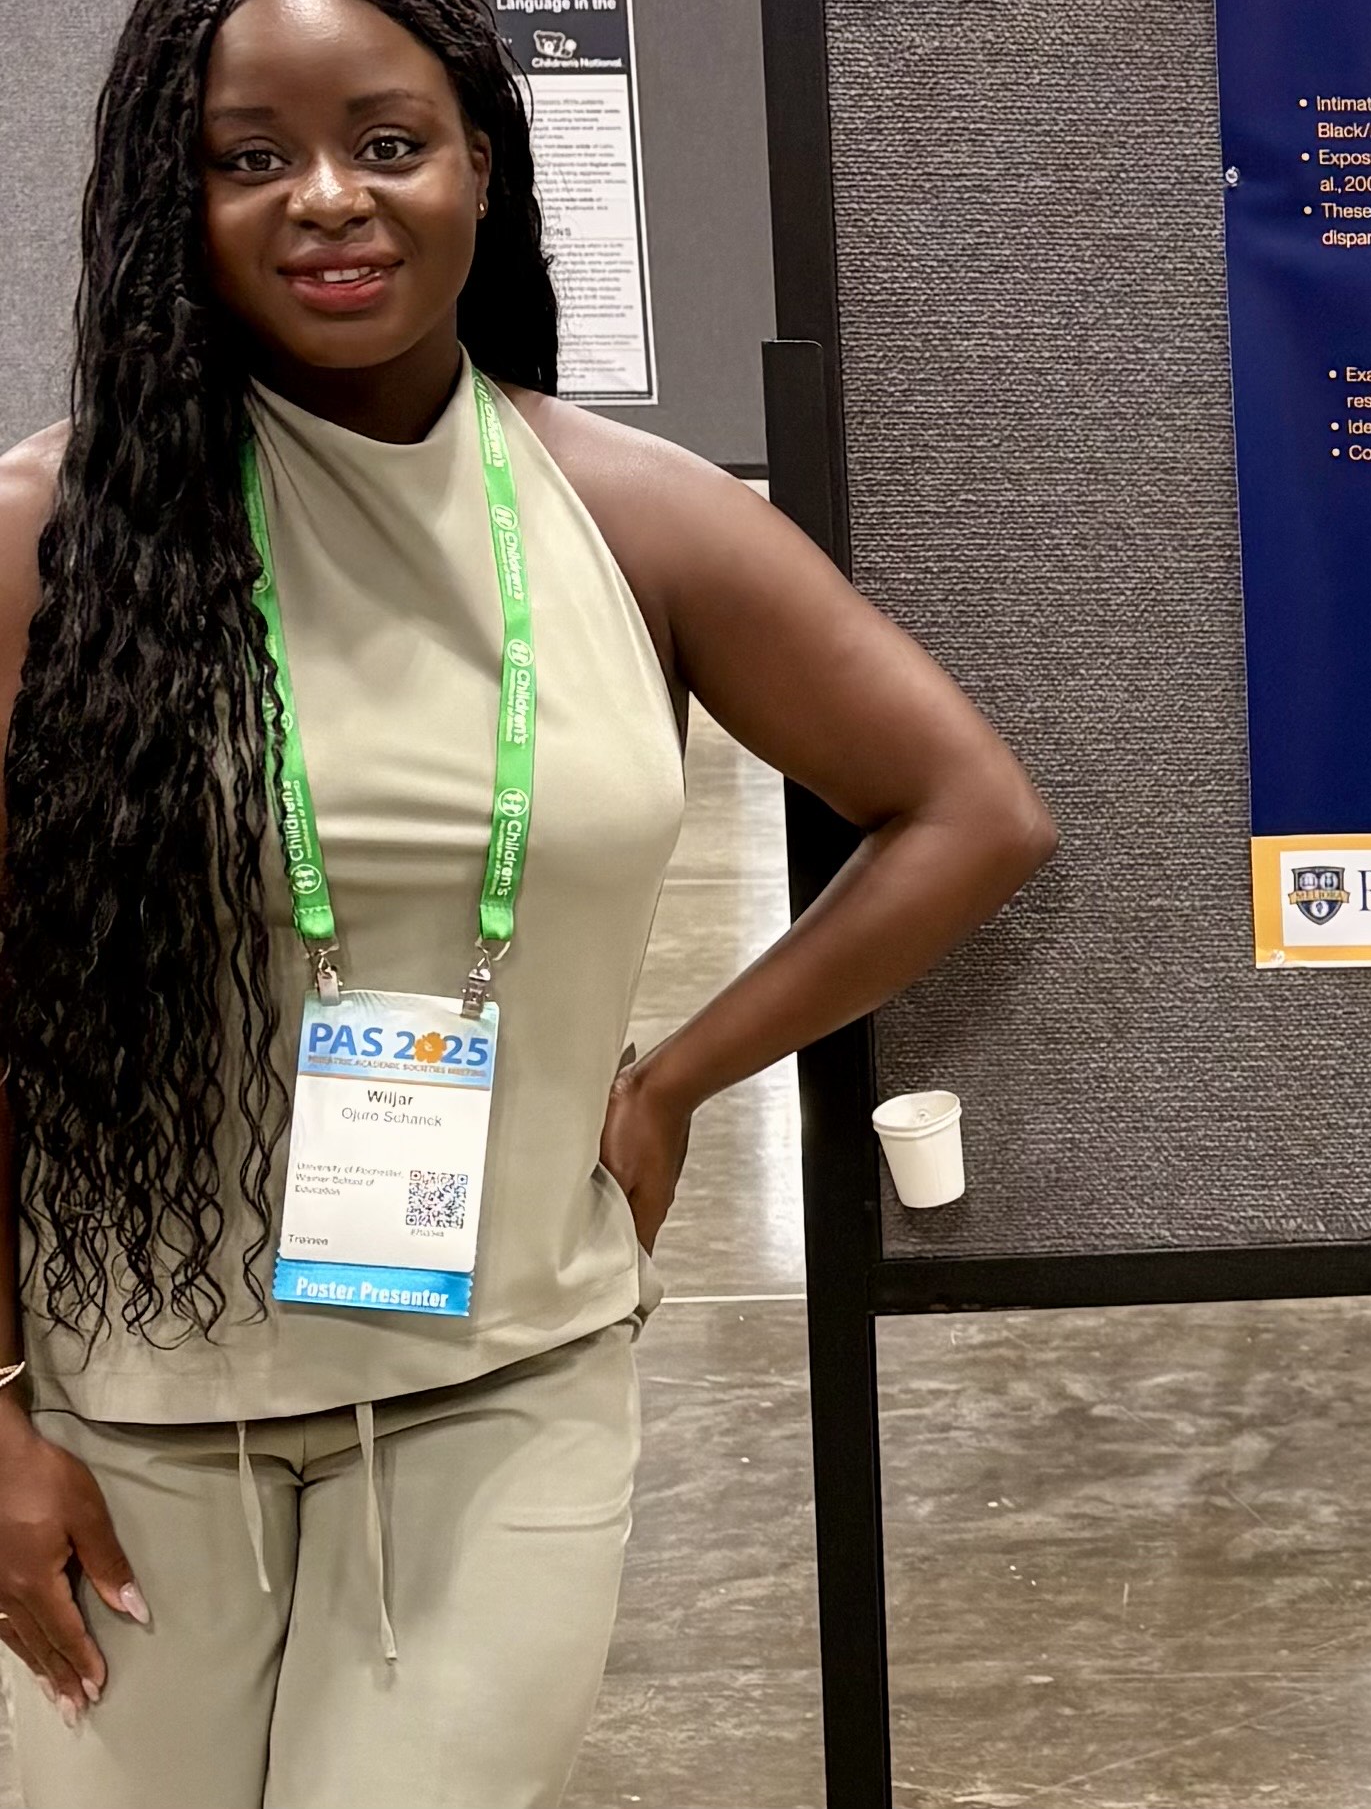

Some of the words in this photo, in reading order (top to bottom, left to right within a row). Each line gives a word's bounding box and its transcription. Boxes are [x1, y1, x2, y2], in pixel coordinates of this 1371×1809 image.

[514, 669, 532, 745] Children's
[497, 820, 523, 897] Children's
[308, 1022, 384, 1057] PAS
[394, 1031, 489, 1067] 225
[367, 1090, 414, 1107] Wiljar
[296, 1276, 355, 1301] Poster
[360, 1281, 449, 1308] Presenter
